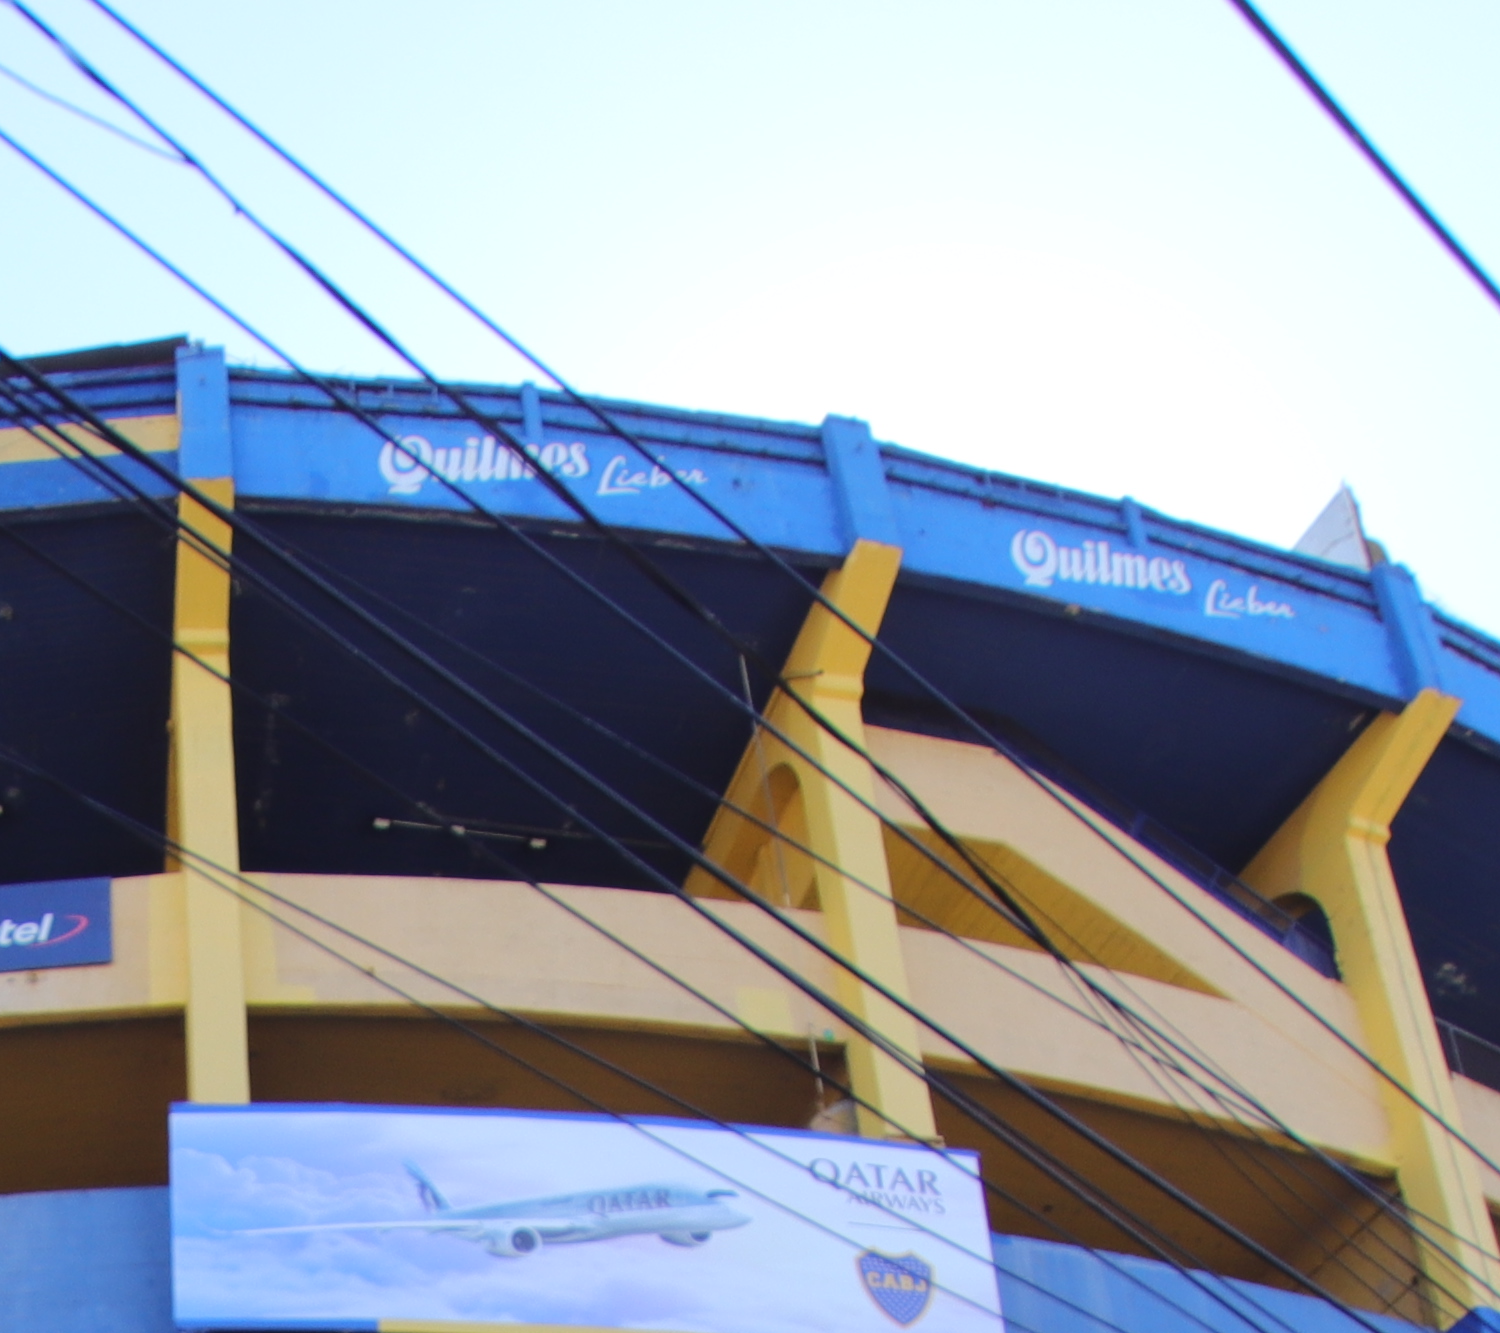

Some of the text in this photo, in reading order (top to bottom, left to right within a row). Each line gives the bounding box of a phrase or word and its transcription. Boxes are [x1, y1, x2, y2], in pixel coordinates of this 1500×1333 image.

[378, 434, 590, 495] Quilmes
[1010, 529, 1193, 595] Quilmes
[808, 1157, 943, 1197] QATAR
[588, 1188, 673, 1218] QATAR
[866, 1269, 928, 1293] CABJ
